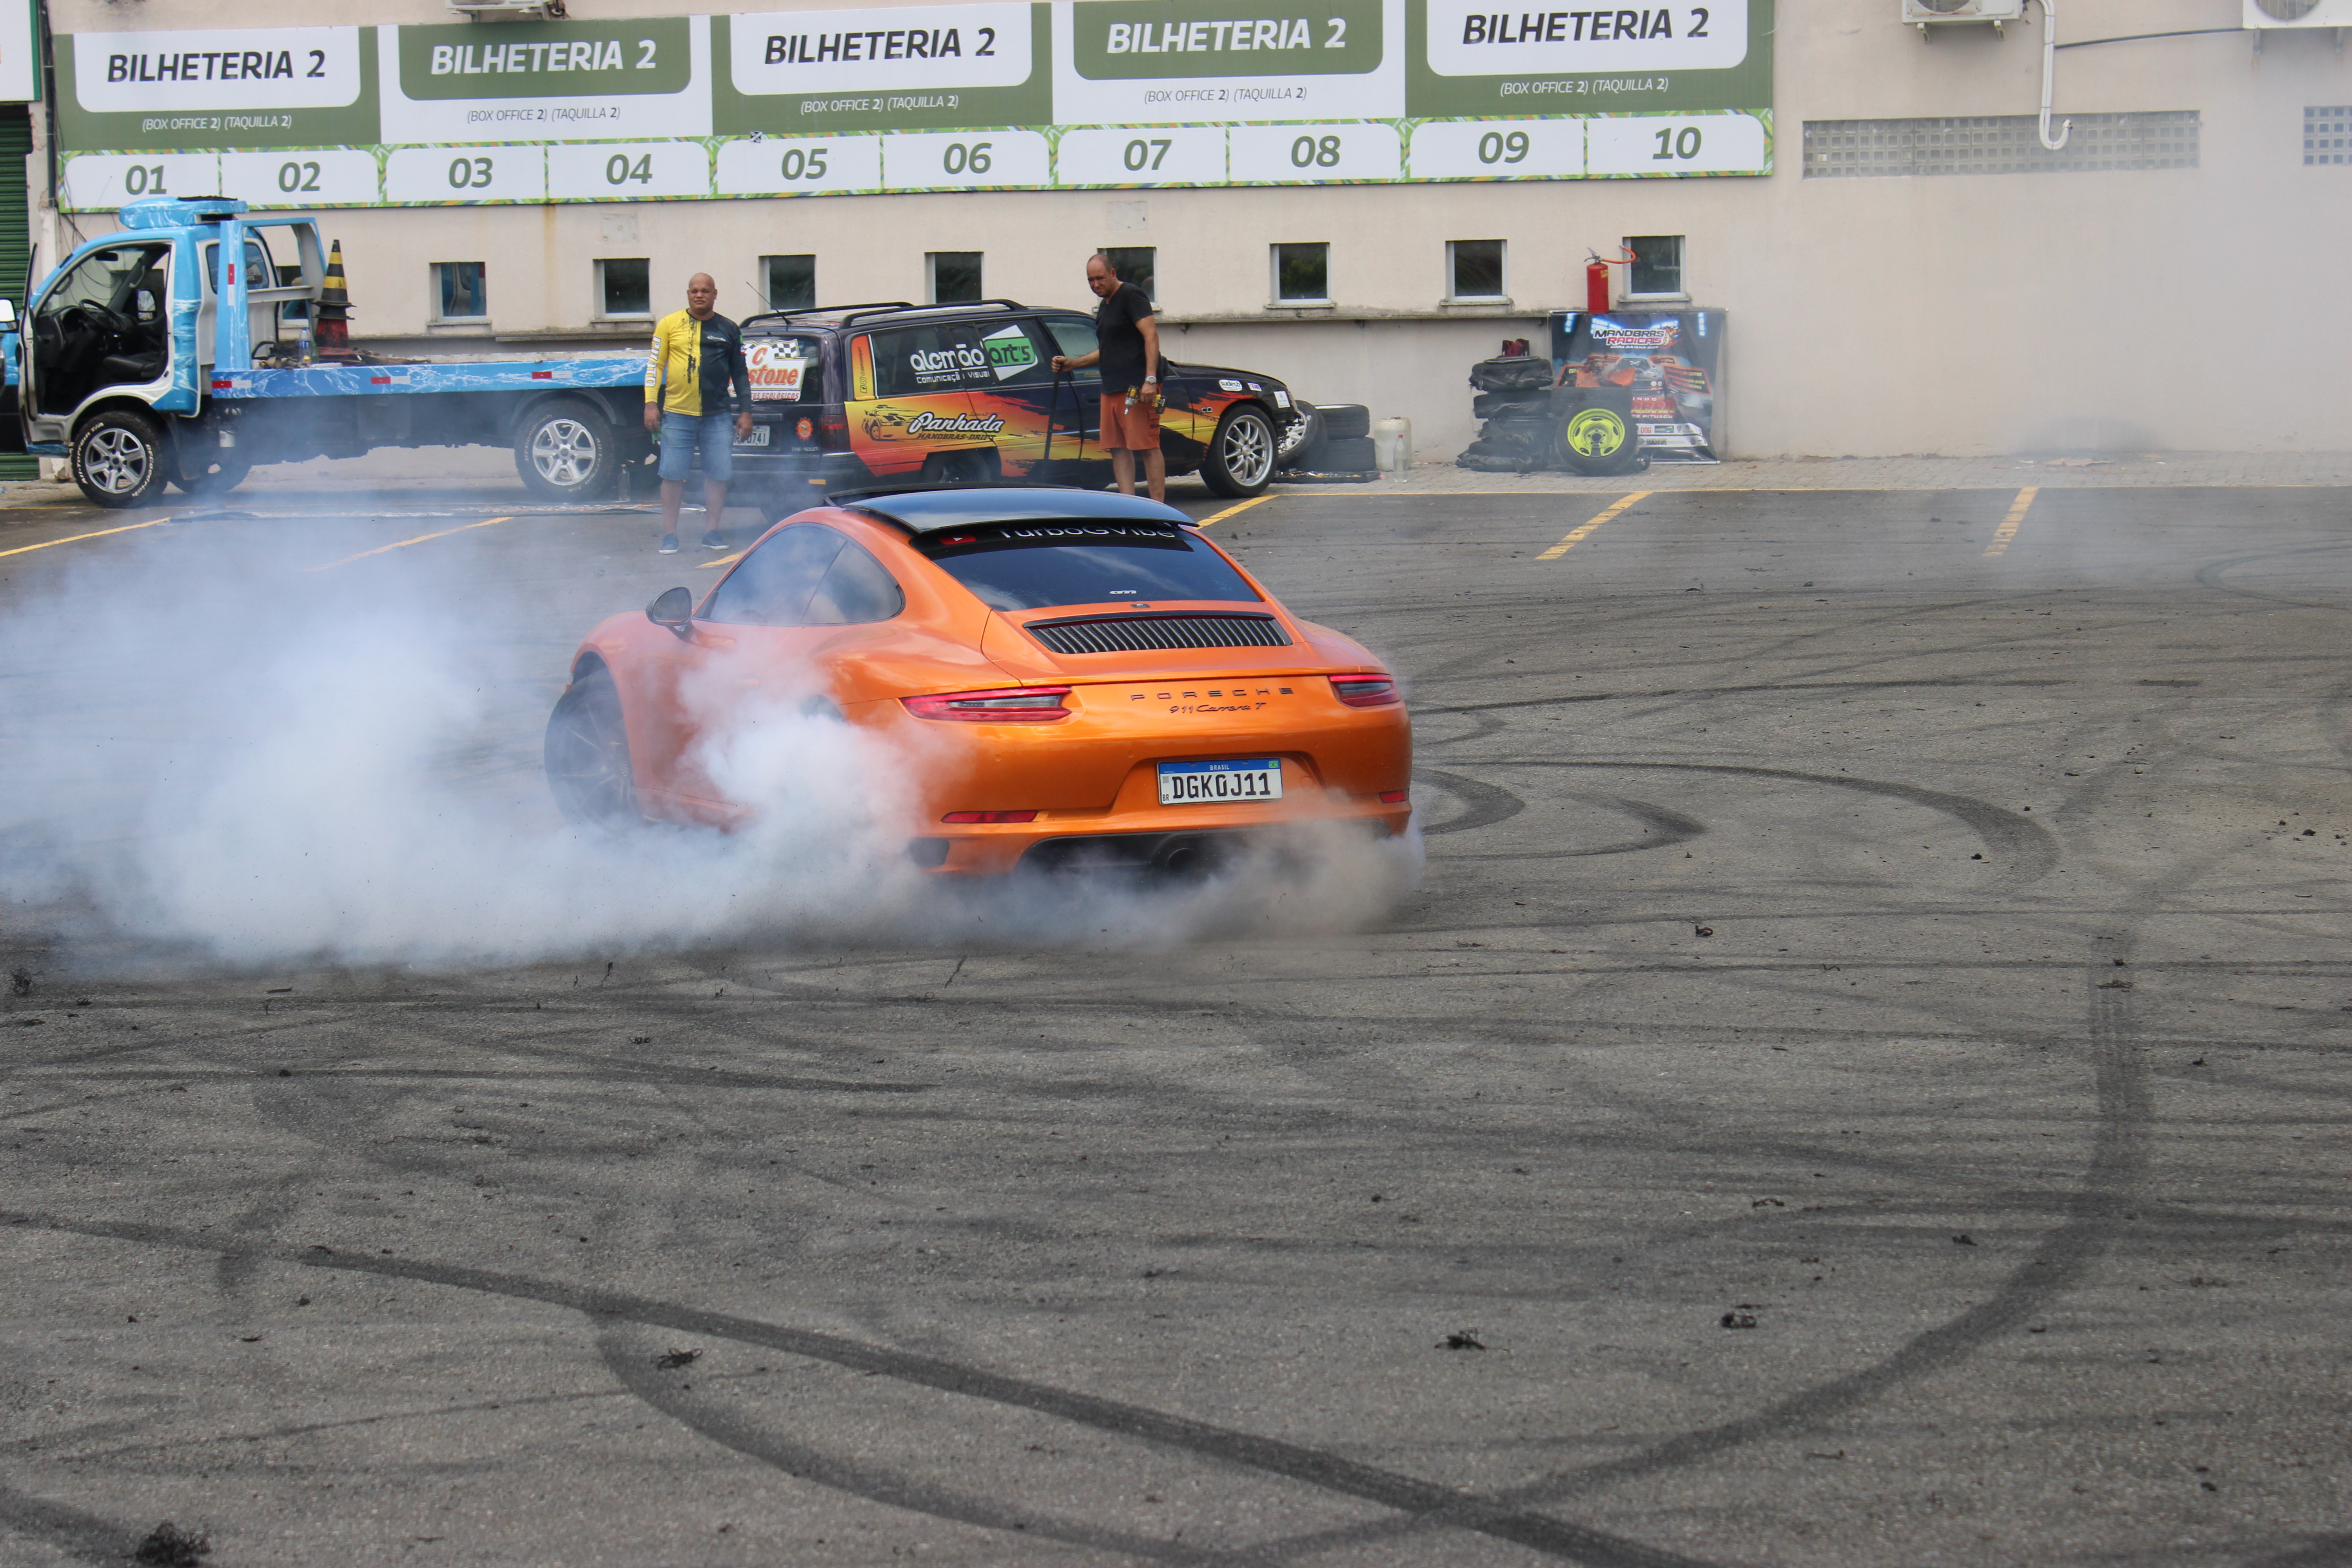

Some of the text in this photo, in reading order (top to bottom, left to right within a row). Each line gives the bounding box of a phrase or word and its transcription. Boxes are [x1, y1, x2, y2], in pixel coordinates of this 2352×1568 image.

[1107, 18, 1346, 53] BILHETERIA 2
[1463, 8, 1708, 44] BILHETERIA 2
[431, 40, 656, 74] BILHETERIA 2
[765, 28, 995, 64] BILHETERIA 2
[108, 50, 325, 82] BILHETERIA 2
[1145, 87, 1307, 104] (BOX OFFICE 2) (TAQUILLA 2)
[1501, 78, 1668, 97] (BOX OFFICE 2) (TAQUILLA 2)
[468, 106, 621, 123] (BOX OFFICE 2) (TAQUILLA 2)
[801, 95, 958, 115] (BOX OFFICE 2) (TAQUILLA 2)
[143, 115, 291, 132] (BOX OFFICE 2) (TAQUILLA 2)
[1124, 140, 1172, 171] 07
[1292, 136, 1340, 167] 08
[1479, 132, 1529, 163] 09
[1653, 127, 1701, 159] 10
[449, 158, 492, 188] 03
[606, 154, 652, 185] 04
[782, 149, 827, 180] 05
[944, 143, 992, 174] 06
[126, 165, 166, 195] 01
[279, 162, 320, 192] 02
[751, 347, 768, 365] C
[748, 364, 799, 385] stone
[907, 412, 1005, 434] Panhada
[990, 525, 1176, 538] TurboGVibe
[1131, 687, 1294, 701] PORSCHE
[1170, 705, 1193, 713] 911
[1172, 772, 1270, 799] DGK0J11
